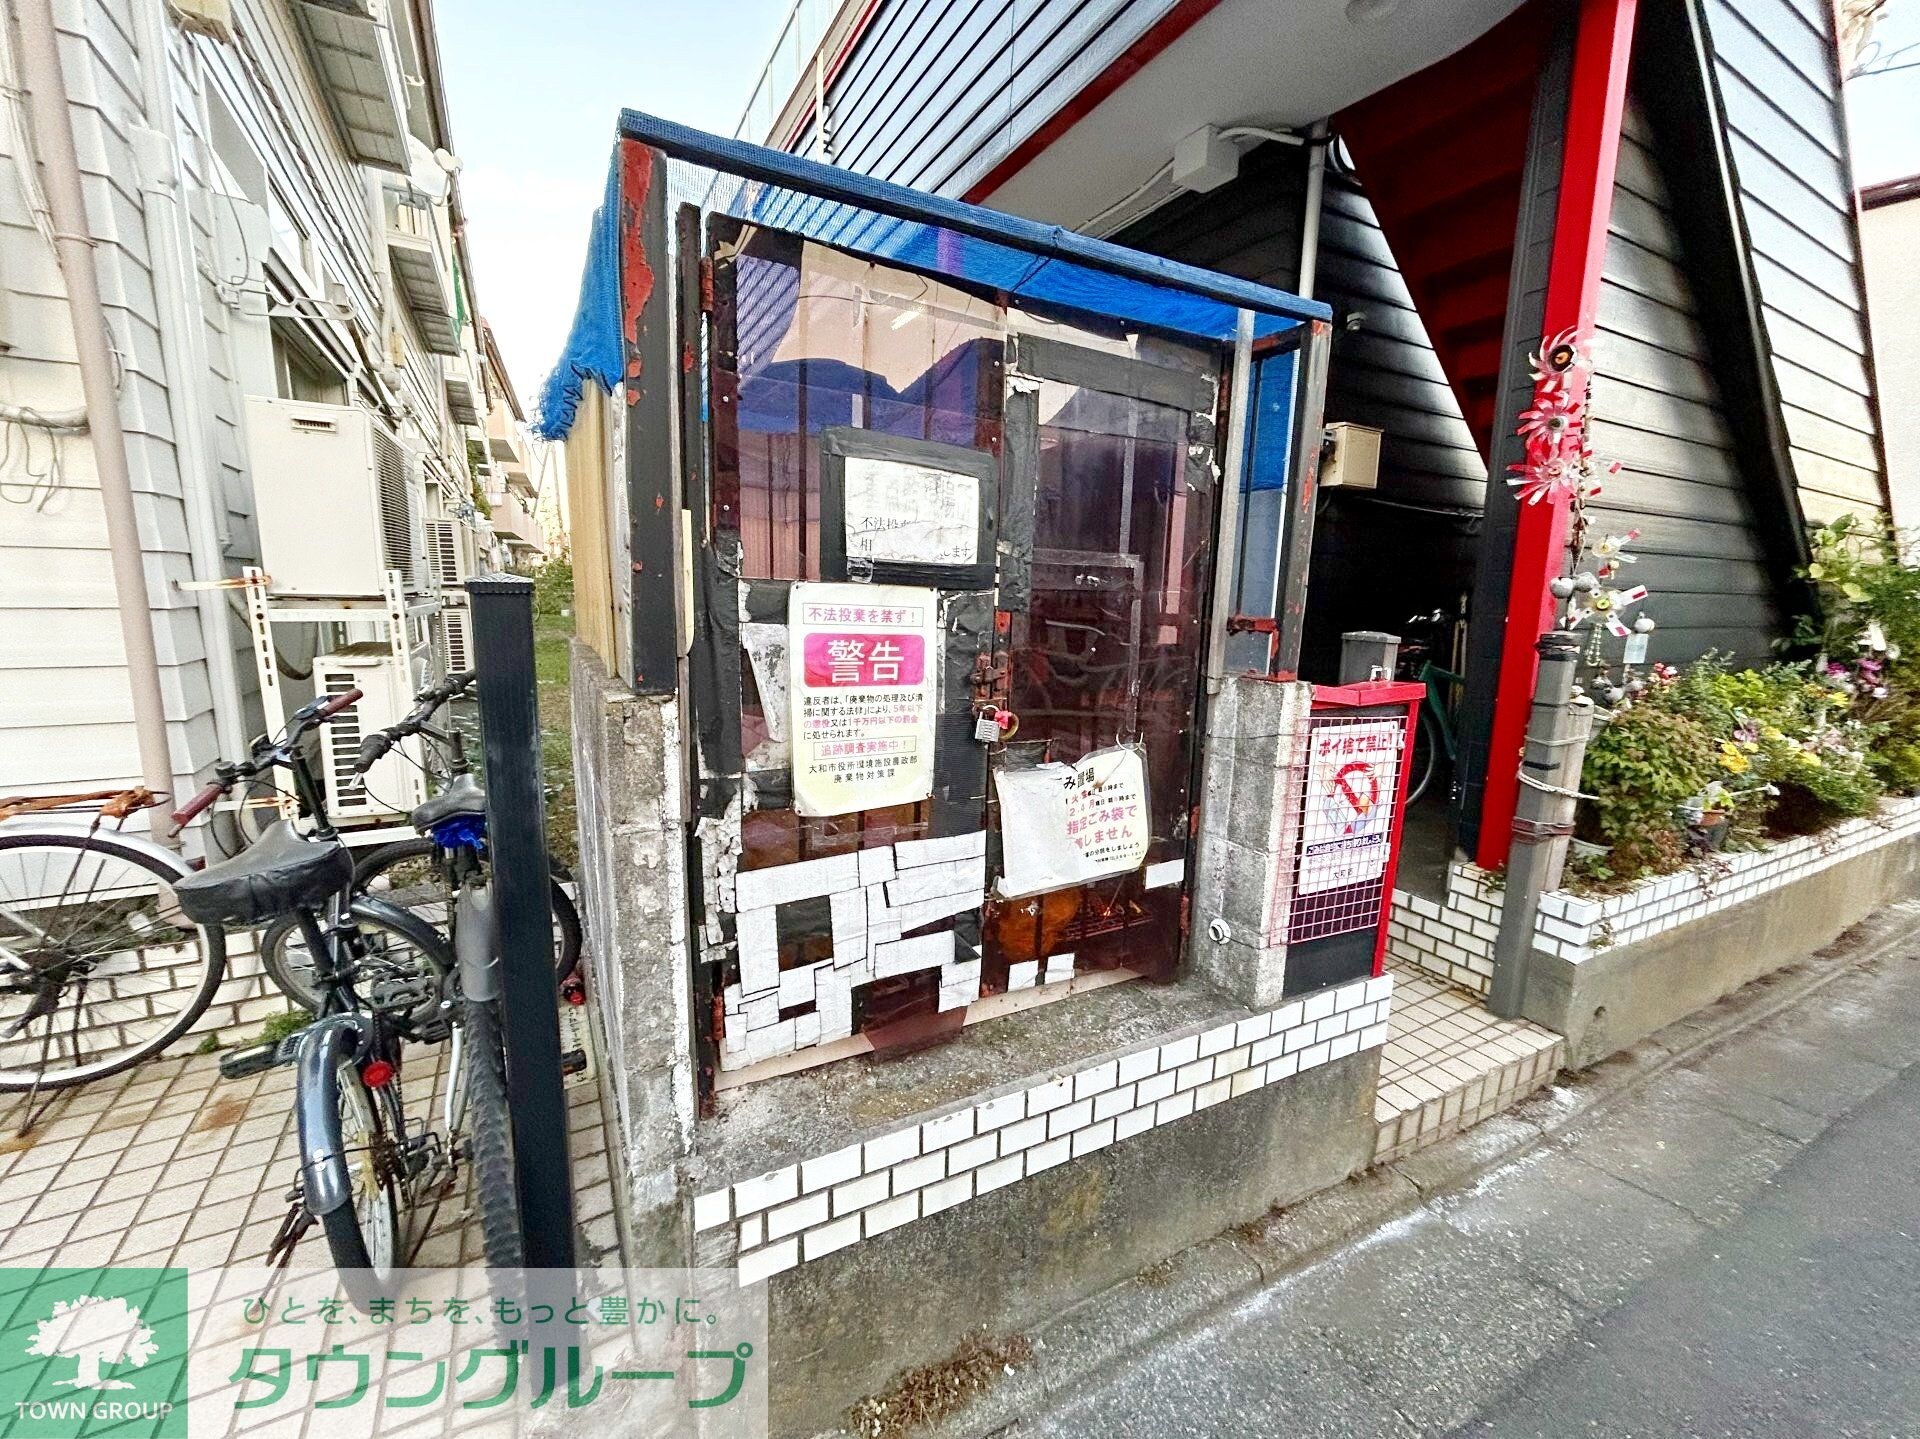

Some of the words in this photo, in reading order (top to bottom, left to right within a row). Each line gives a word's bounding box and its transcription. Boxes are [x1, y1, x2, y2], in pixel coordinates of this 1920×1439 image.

[827, 639, 905, 684] 警告
[833, 768, 895, 783] 廃棄物対策課
[1058, 767, 1095, 790] み置場
[1066, 805, 1137, 835] 指定ごみ袋で
